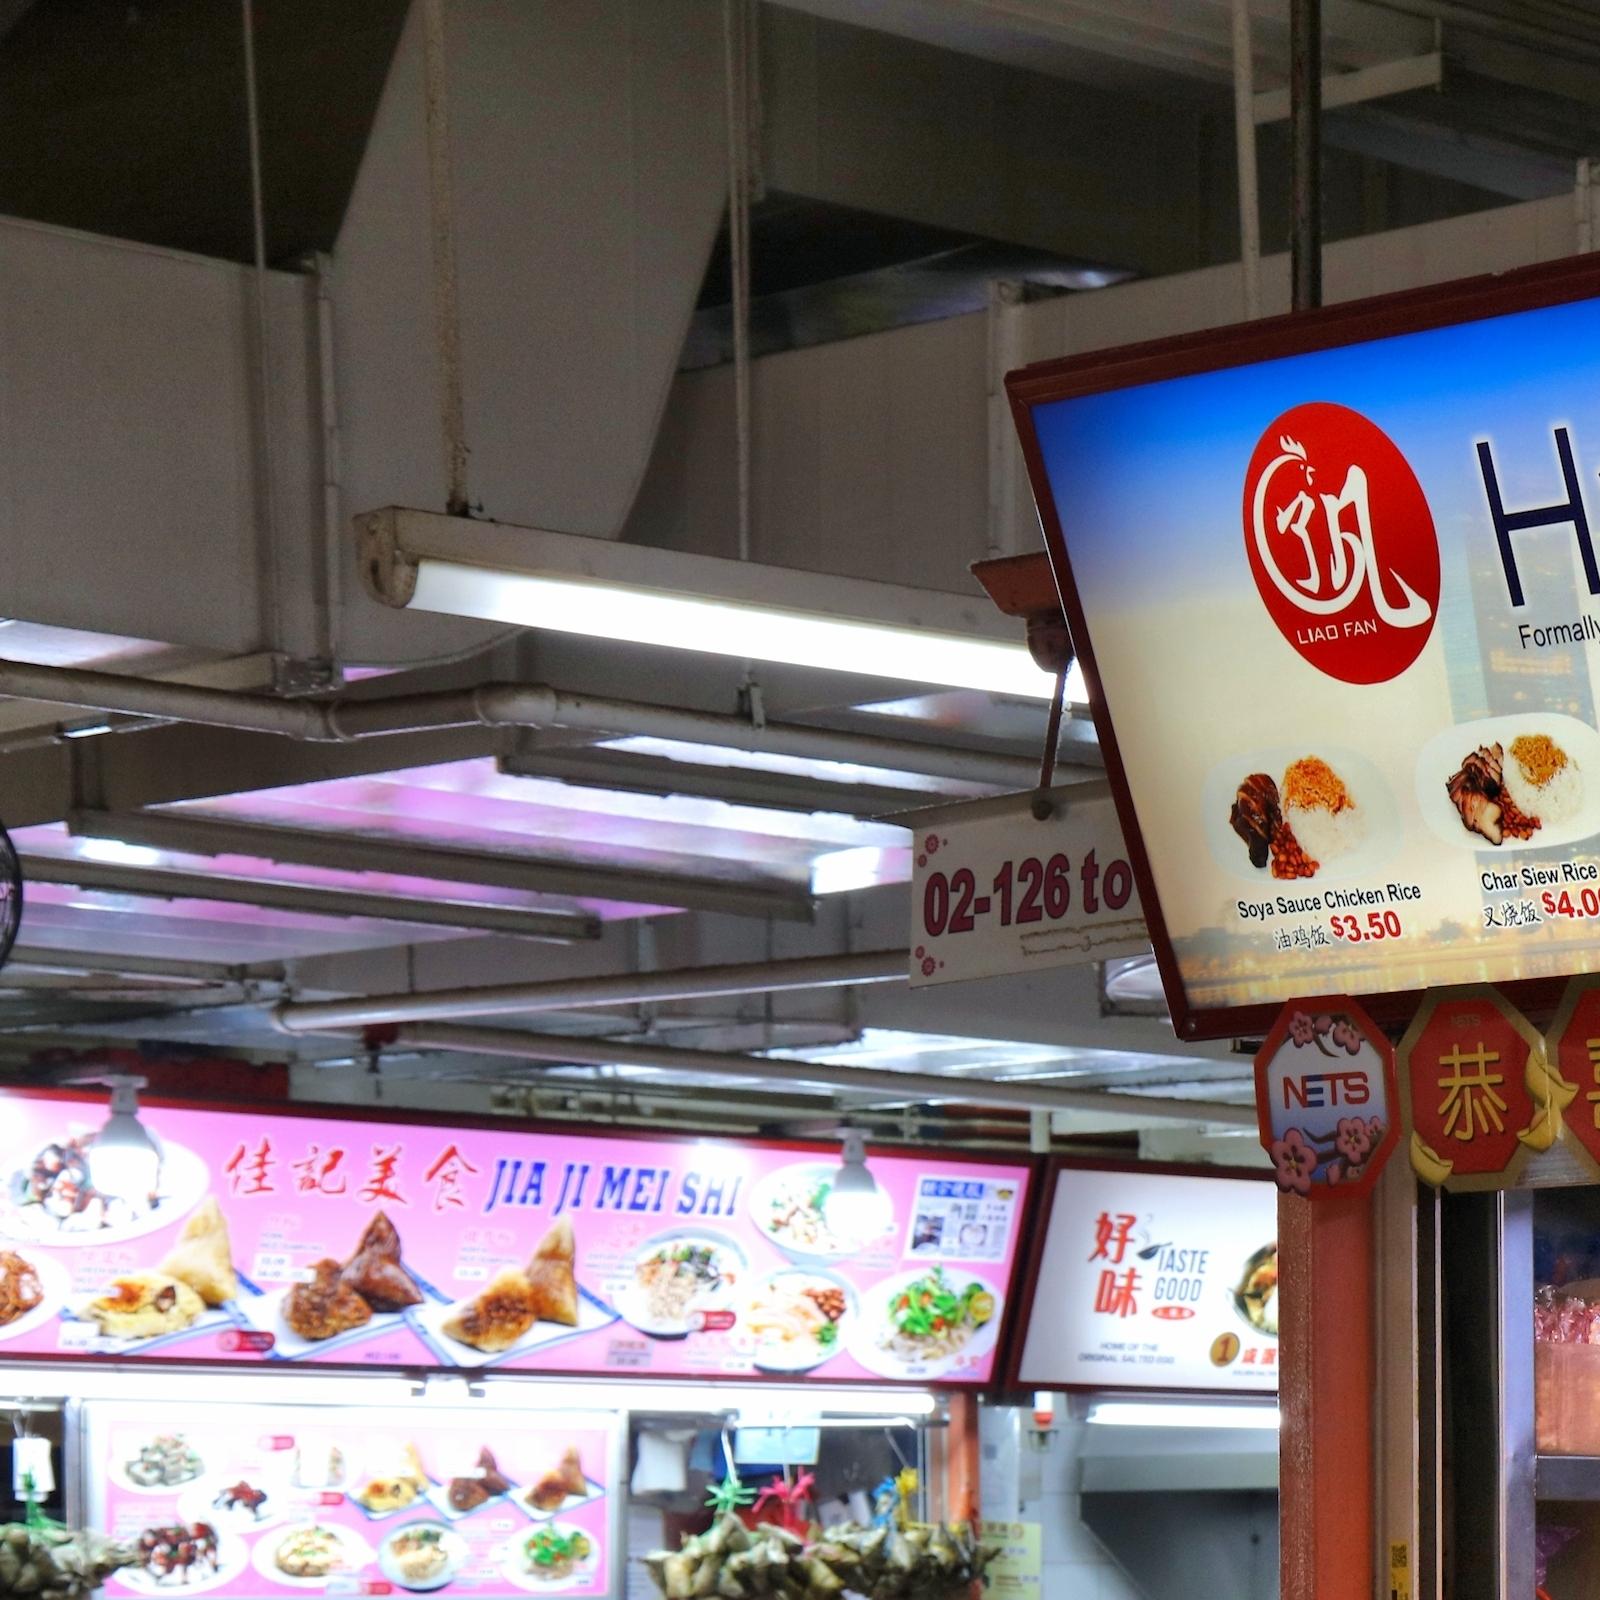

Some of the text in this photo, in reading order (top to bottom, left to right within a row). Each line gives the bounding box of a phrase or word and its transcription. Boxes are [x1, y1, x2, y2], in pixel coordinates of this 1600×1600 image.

[1297, 618, 1377, 645] LIAO FAN
[924, 848, 1132, 937] 02-126 to
[1481, 864, 1598, 892] Char Siew Rice
[1238, 883, 1421, 921] Soya Sauce Chicken Rice
[1484, 904, 1542, 928] 叉烧饭
[1274, 910, 1402, 950] 油鸡饭 $3.50
[1282, 1071, 1371, 1110] NETS
[1437, 1041, 1508, 1141] 恭
[226, 1137, 479, 1210] 佳記美食
[486, 1159, 746, 1221] JIA JI MEI SHI
[1088, 1211, 1142, 1318] 好味
[1158, 1248, 1210, 1274] TASTE
[1154, 1277, 1202, 1301] GOOD
